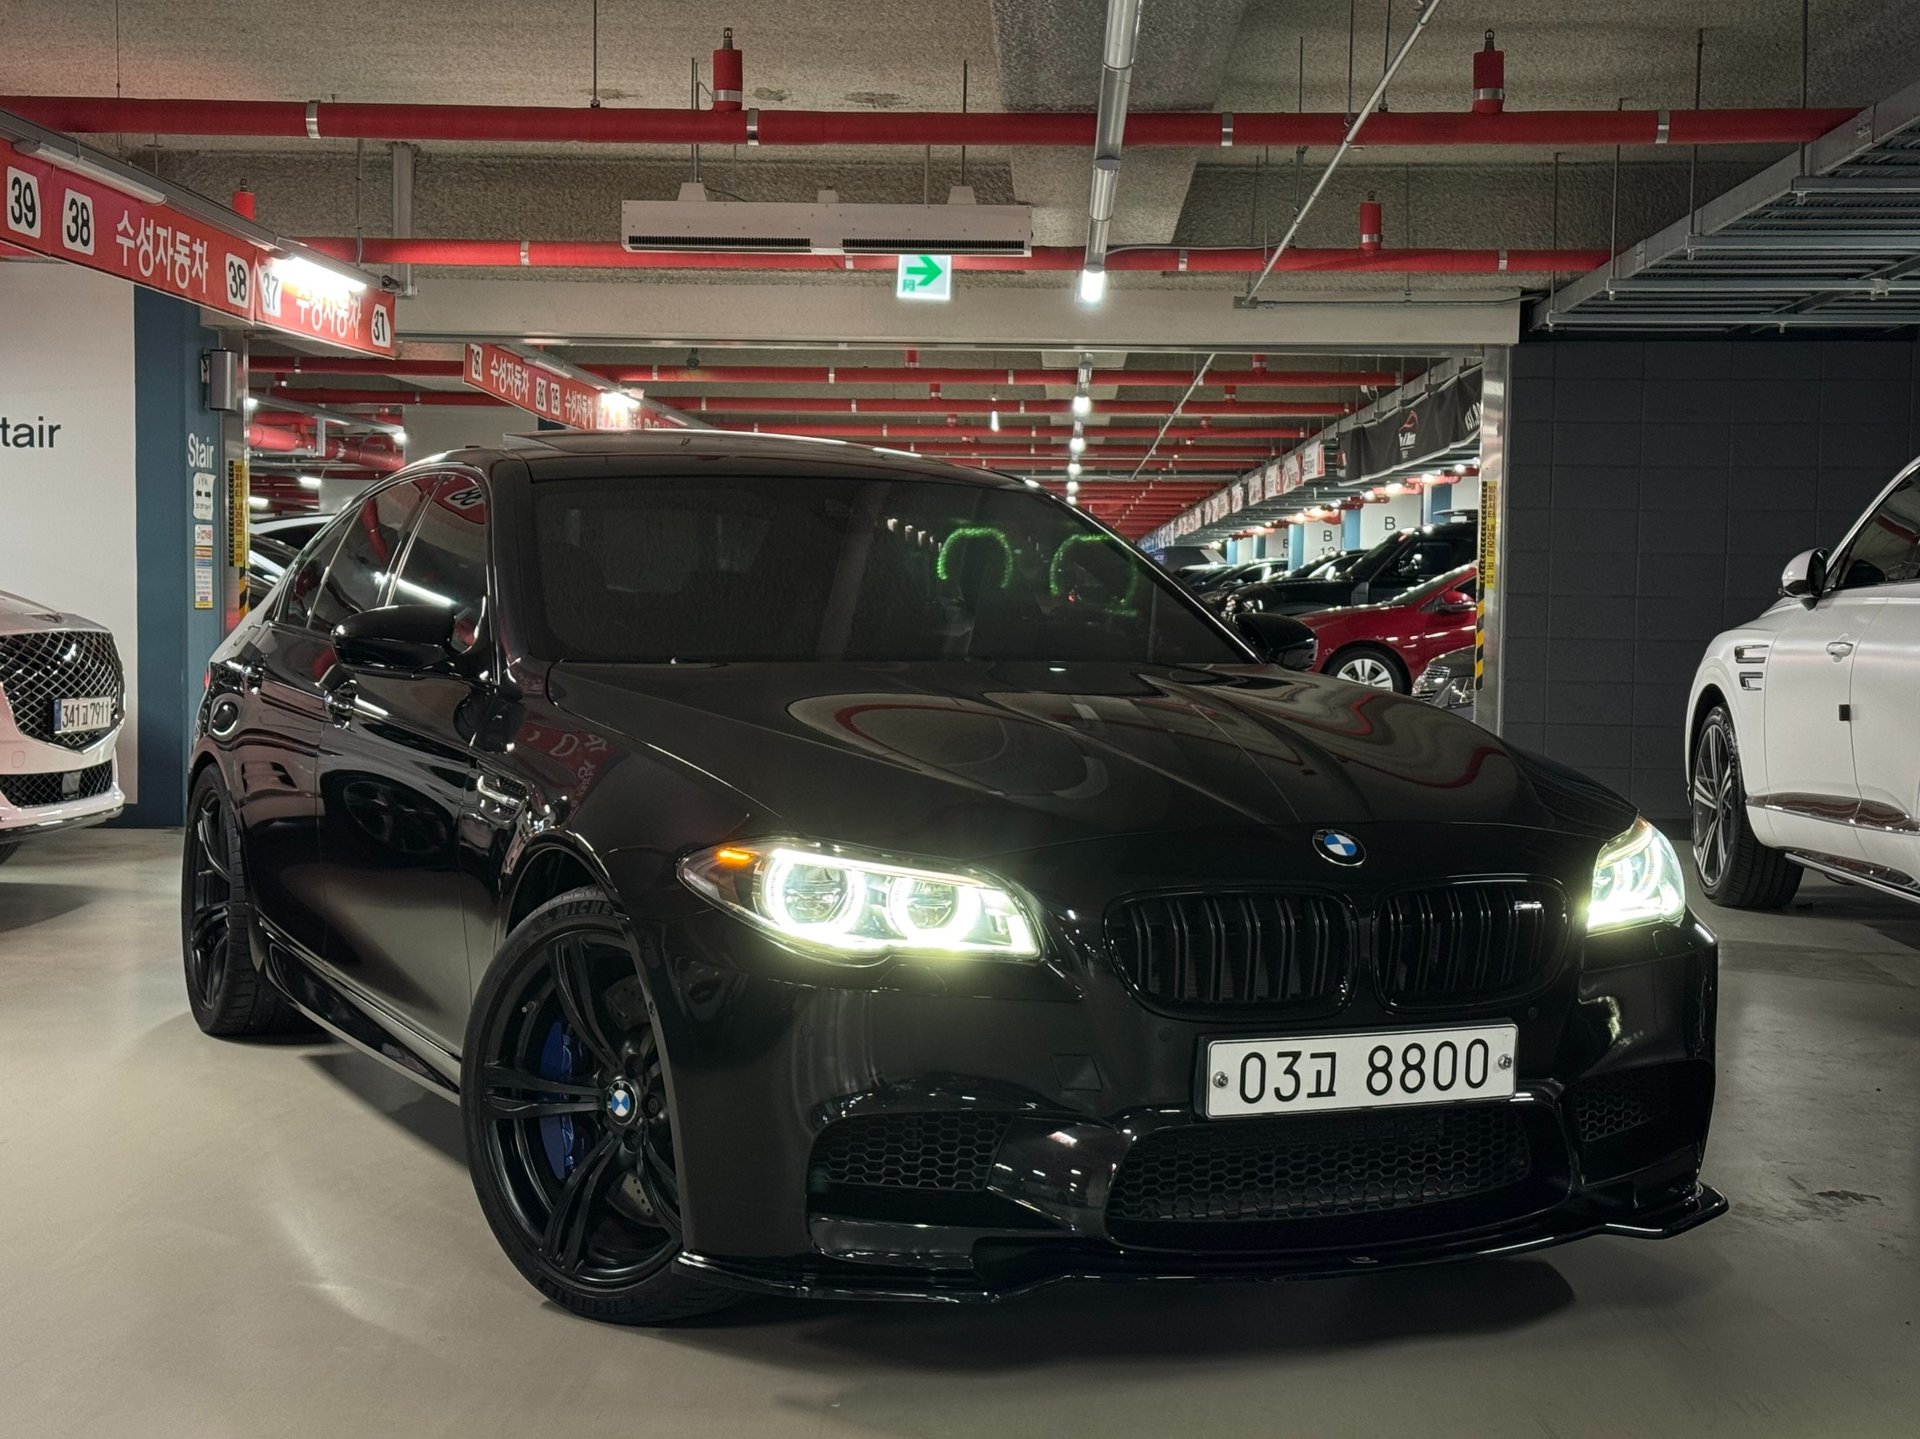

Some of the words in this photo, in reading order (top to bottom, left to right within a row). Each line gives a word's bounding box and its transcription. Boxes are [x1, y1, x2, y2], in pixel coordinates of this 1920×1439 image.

[11, 176, 37, 230] 39
[66, 197, 91, 247] 38
[116, 209, 209, 294] 수성자동차
[228, 260, 247, 304] 38
[263, 272, 279, 310] 37
[373, 309, 386, 342] 37
[490, 353, 529, 403] 수성자동차
[188, 432, 214, 469] Stair
[1323, 530, 1333, 542] B
[1384, 516, 1396, 531] B
[62, 704, 88, 728] 341고
[90, 701, 109, 725] 7911
[1238, 1050, 1337, 1104] 03고
[1366, 1037, 1490, 1096] 8800
